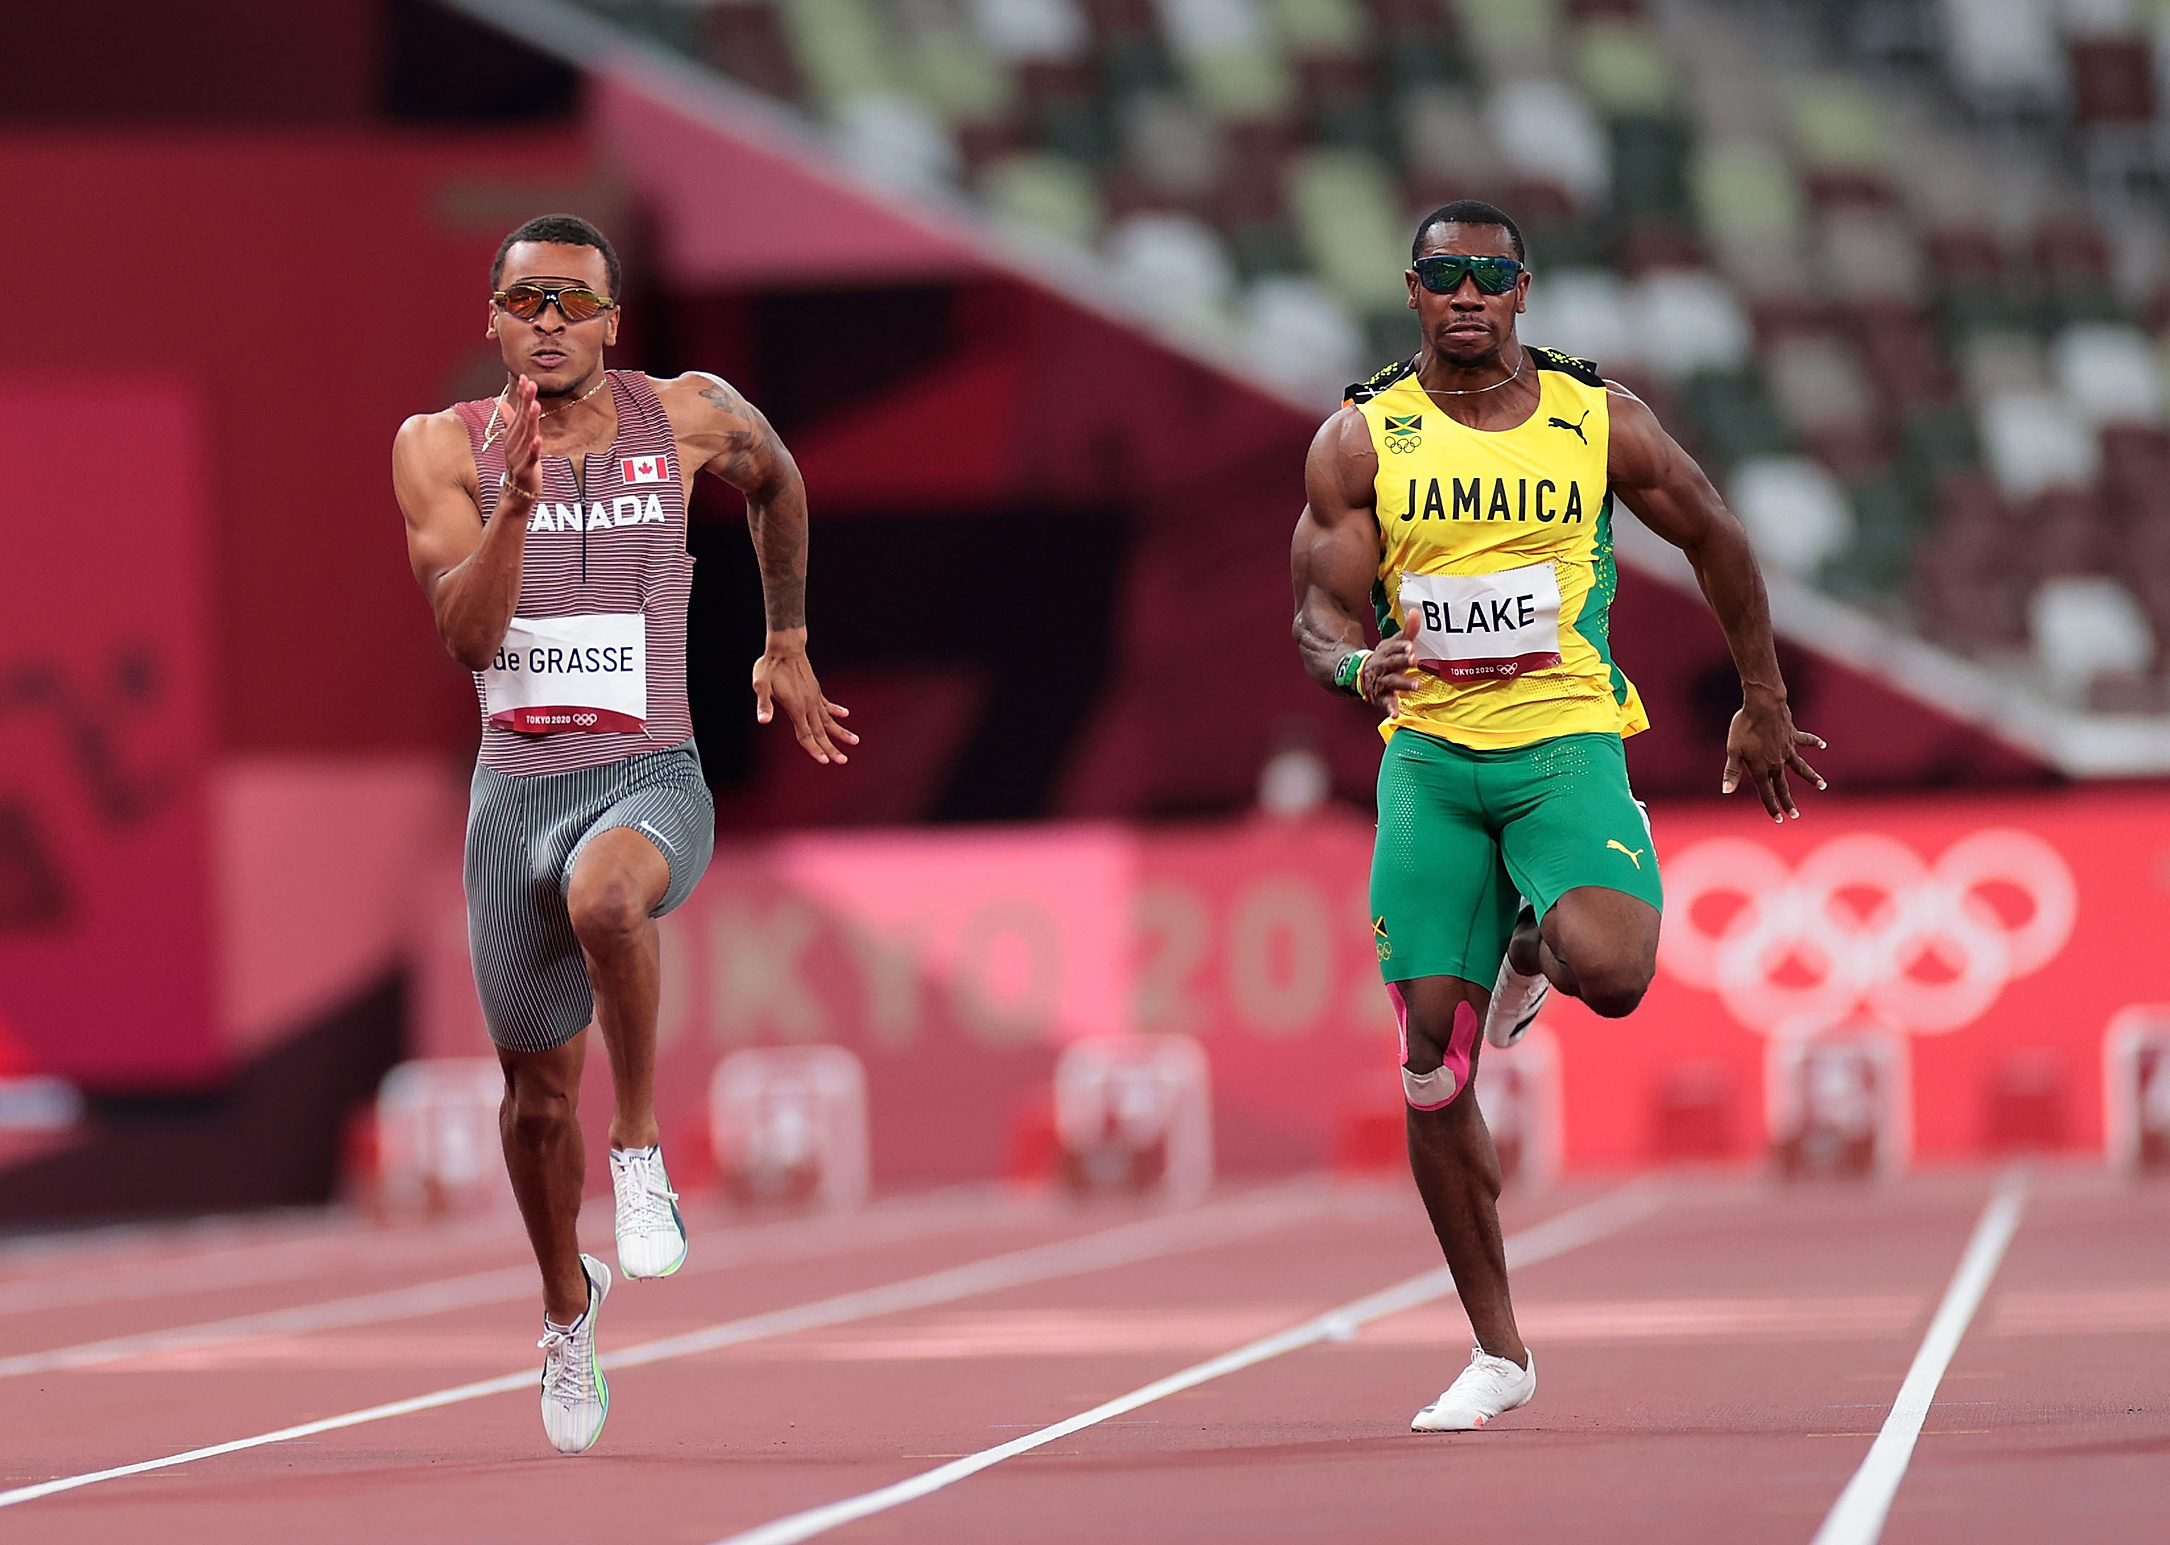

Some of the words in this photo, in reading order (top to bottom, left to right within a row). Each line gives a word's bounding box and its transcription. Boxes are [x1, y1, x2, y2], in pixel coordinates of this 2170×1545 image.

[527, 493, 665, 532] ANADA
[1400, 477, 1582, 524] JAMAICA
[1422, 593, 1535, 634] BLAKE
[493, 646, 520, 672] de
[529, 646, 634, 674] GRASSE
[1451, 667, 1475, 677] TOKYO
[1475, 666, 1495, 675] 2020
[526, 714, 551, 725] TOKYO
[551, 715, 571, 724] 2020
